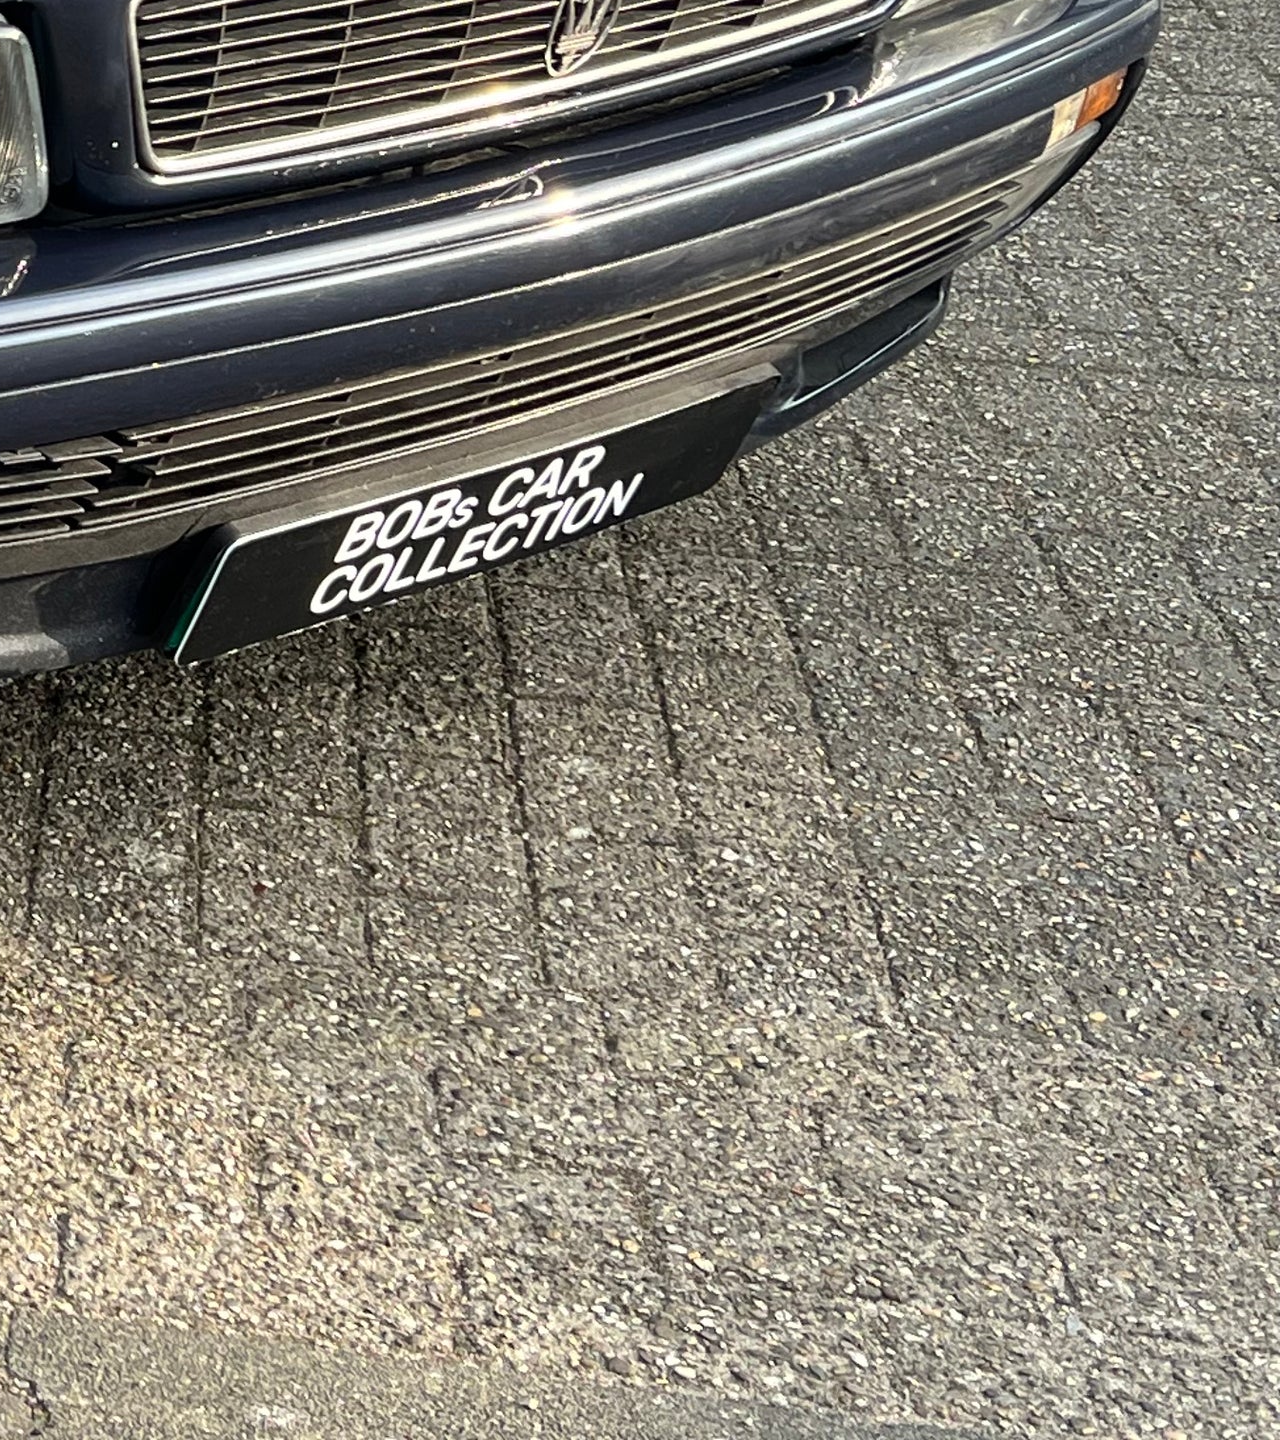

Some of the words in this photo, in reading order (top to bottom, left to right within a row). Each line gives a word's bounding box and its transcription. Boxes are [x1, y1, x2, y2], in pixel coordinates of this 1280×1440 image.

[310, 473, 644, 614] COLLECTION
[334, 488, 479, 563] BOBs
[488, 445, 606, 516] CAR
